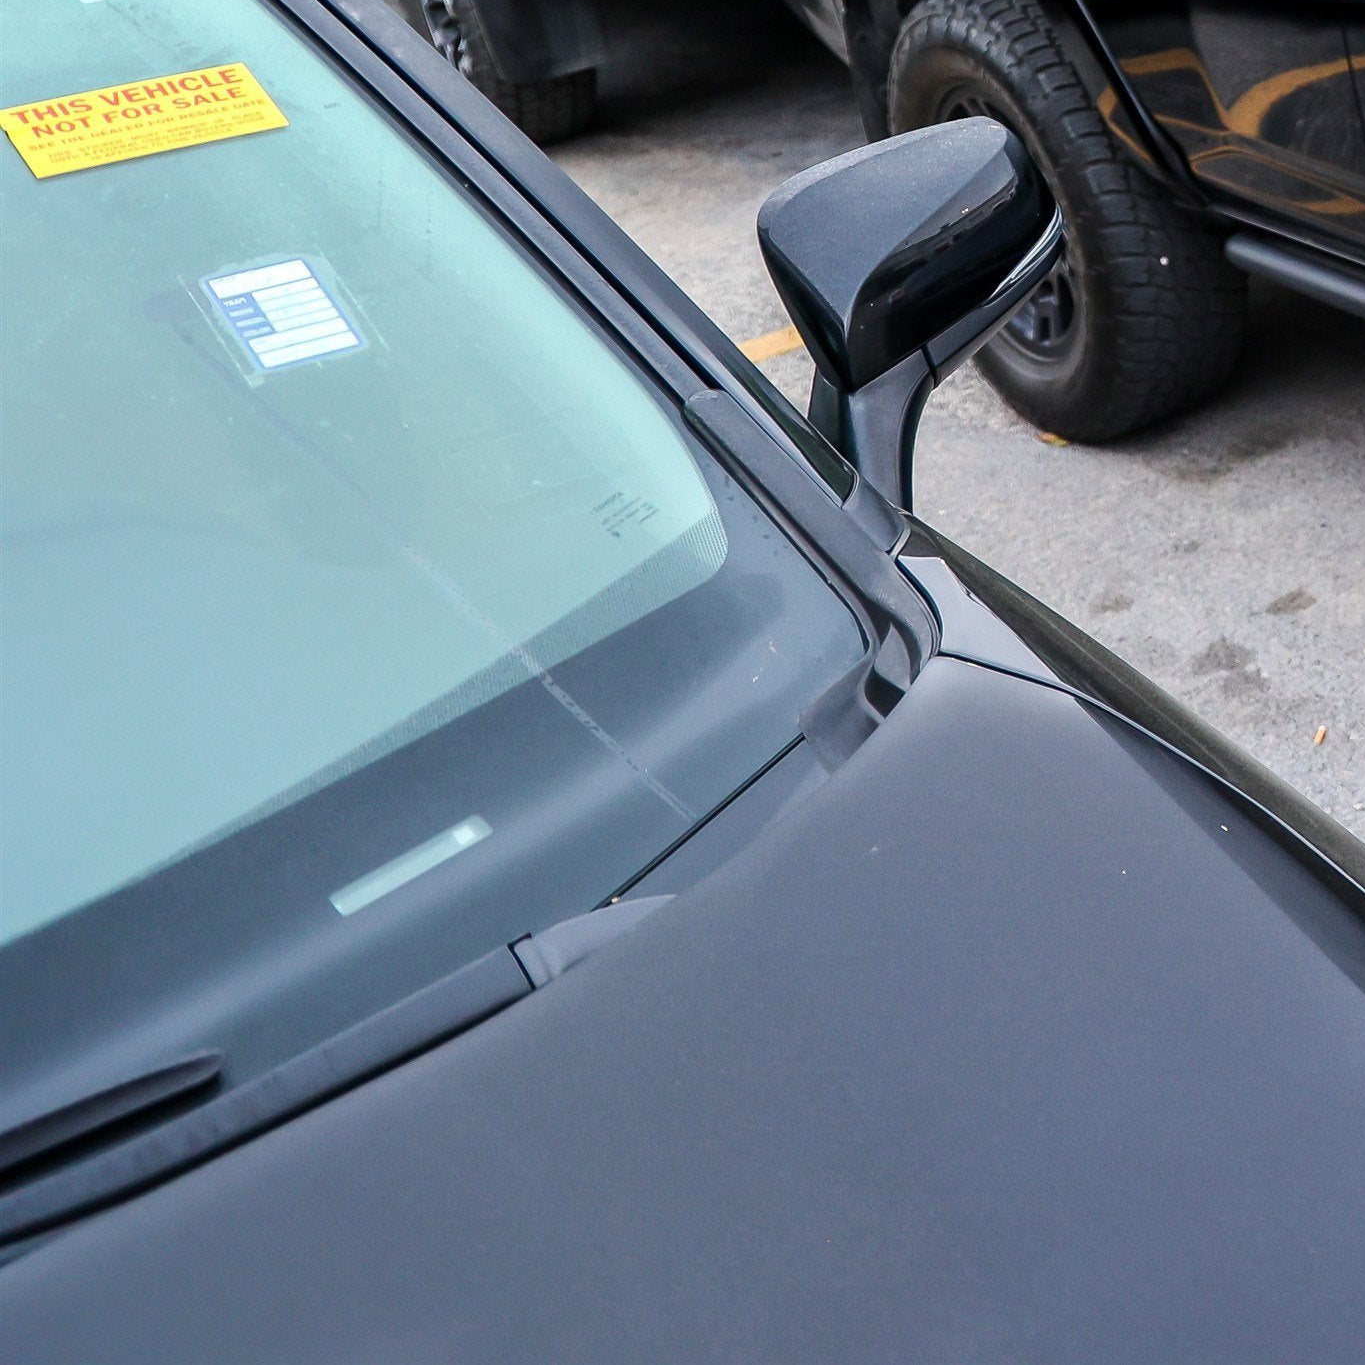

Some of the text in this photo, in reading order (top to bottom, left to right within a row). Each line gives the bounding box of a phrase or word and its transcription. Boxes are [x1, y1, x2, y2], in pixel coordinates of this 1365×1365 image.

[9, 68, 243, 124] THIS VEHICLE
[31, 87, 247, 138] NOT FOR SALE
